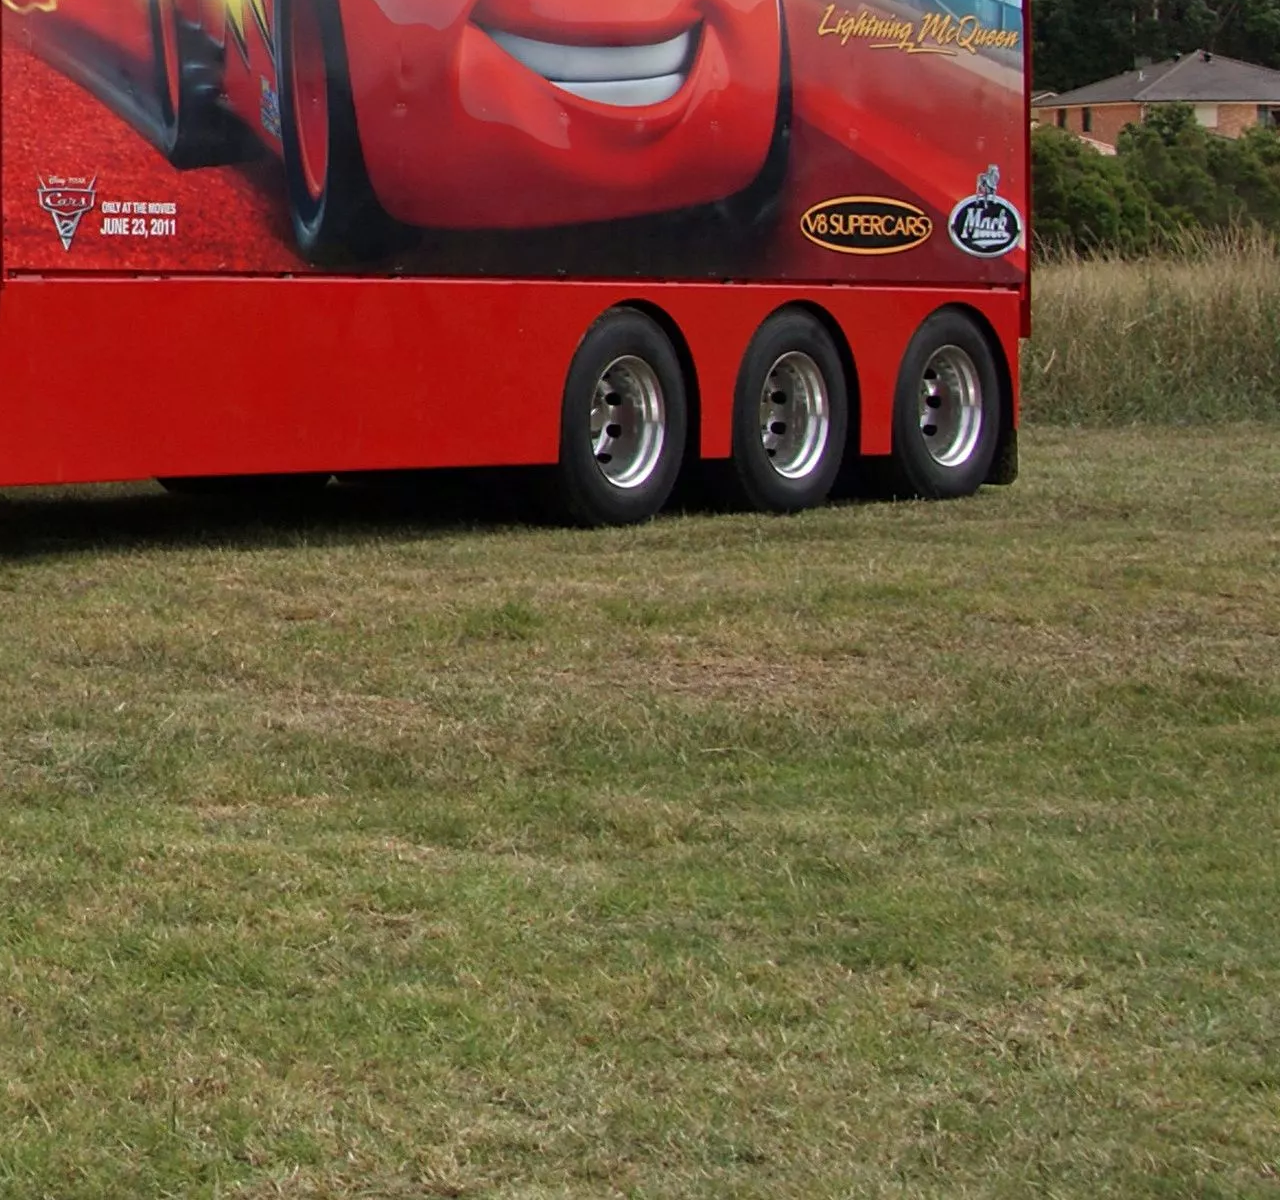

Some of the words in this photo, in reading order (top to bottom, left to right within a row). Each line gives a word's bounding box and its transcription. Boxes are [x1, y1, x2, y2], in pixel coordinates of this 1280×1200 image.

[818, 3, 914, 48] Lightning
[917, 12, 1020, 54] McQueen
[45, 192, 86, 207] Cars
[122, 202, 131, 214] AT
[100, 217, 129, 235] JUNE
[131, 218, 149, 239] 23,
[150, 218, 176, 236] 2011
[805, 213, 828, 234] V8
[829, 213, 929, 237] SUPERCARS
[960, 208, 1008, 238] Mack
